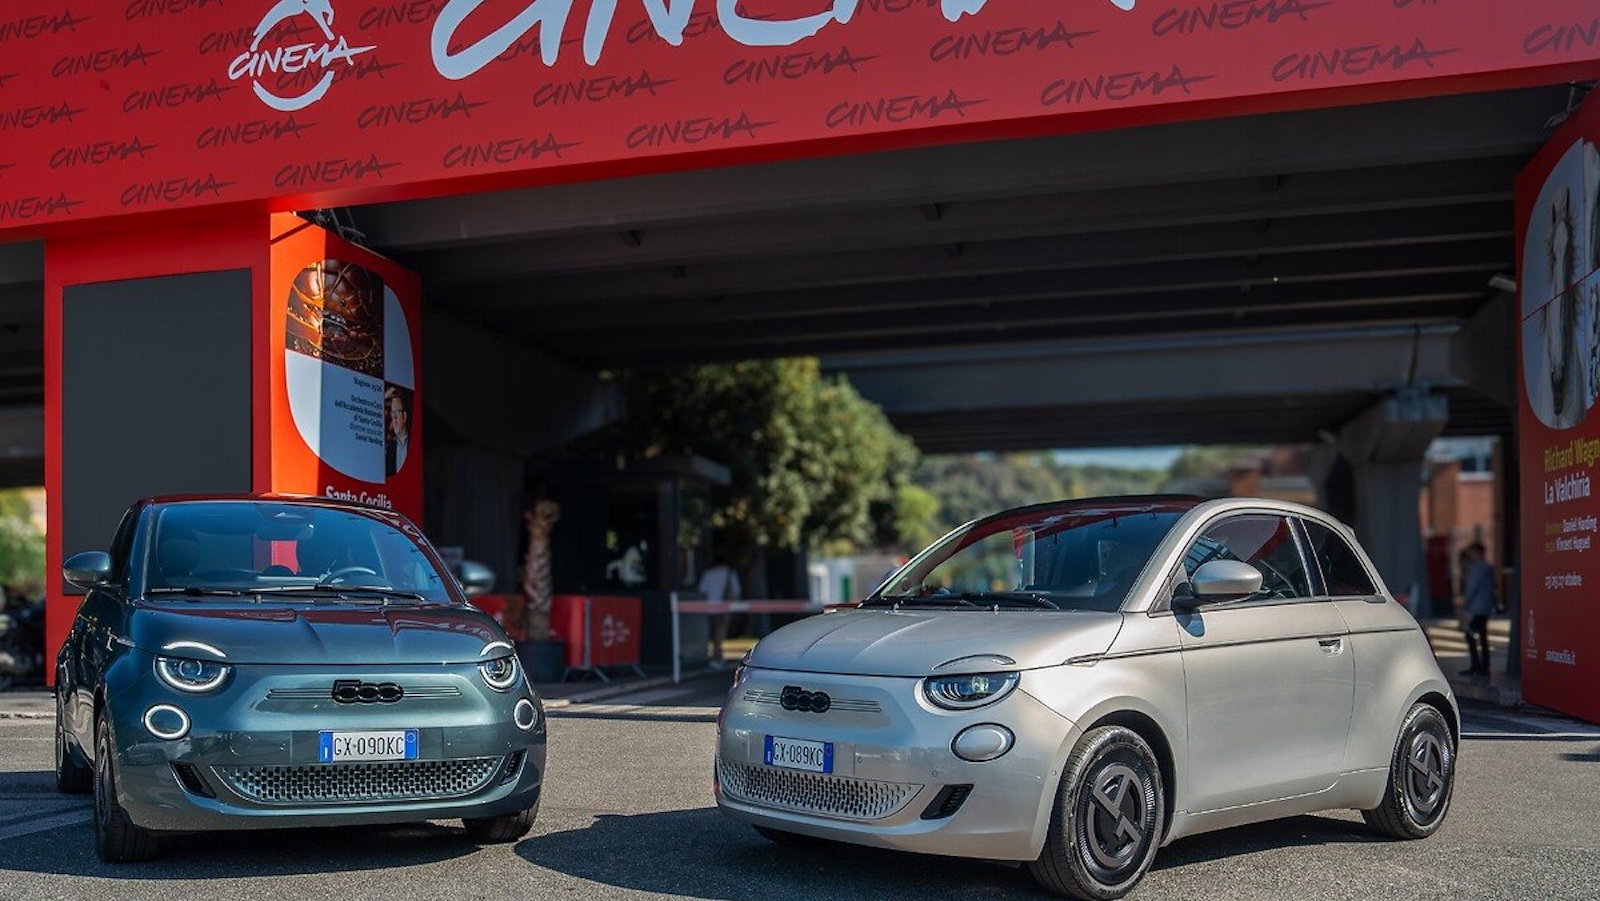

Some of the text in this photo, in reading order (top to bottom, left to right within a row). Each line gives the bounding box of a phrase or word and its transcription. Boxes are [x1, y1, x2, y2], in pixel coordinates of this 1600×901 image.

[1151, 0, 1334, 36] CINEMA
[228, 35, 377, 80] CINEMA
[930, 20, 1098, 62] CINEMA
[52, 43, 163, 78] CINEMA
[724, 46, 882, 85] CINEMA
[1271, 37, 1463, 82] CINEMA
[122, 78, 238, 114] CINEMA
[533, 69, 678, 107] CINEMA
[1040, 64, 1216, 107] CINEMA
[357, 93, 490, 129] CINEMA
[825, 88, 990, 129] CINEMA
[196, 114, 319, 150] CINEMA
[626, 111, 776, 150] CINEMA
[48, 135, 160, 170] CINEMA
[443, 132, 583, 169] CINEMA
[274, 153, 402, 188] CINEMA
[120, 172, 237, 207] CINEMA
[1545, 441, 1573, 472] Richard
[1544, 471, 1590, 505] La Valchiria
[331, 679, 404, 705] 500
[780, 685, 831, 713] 500
